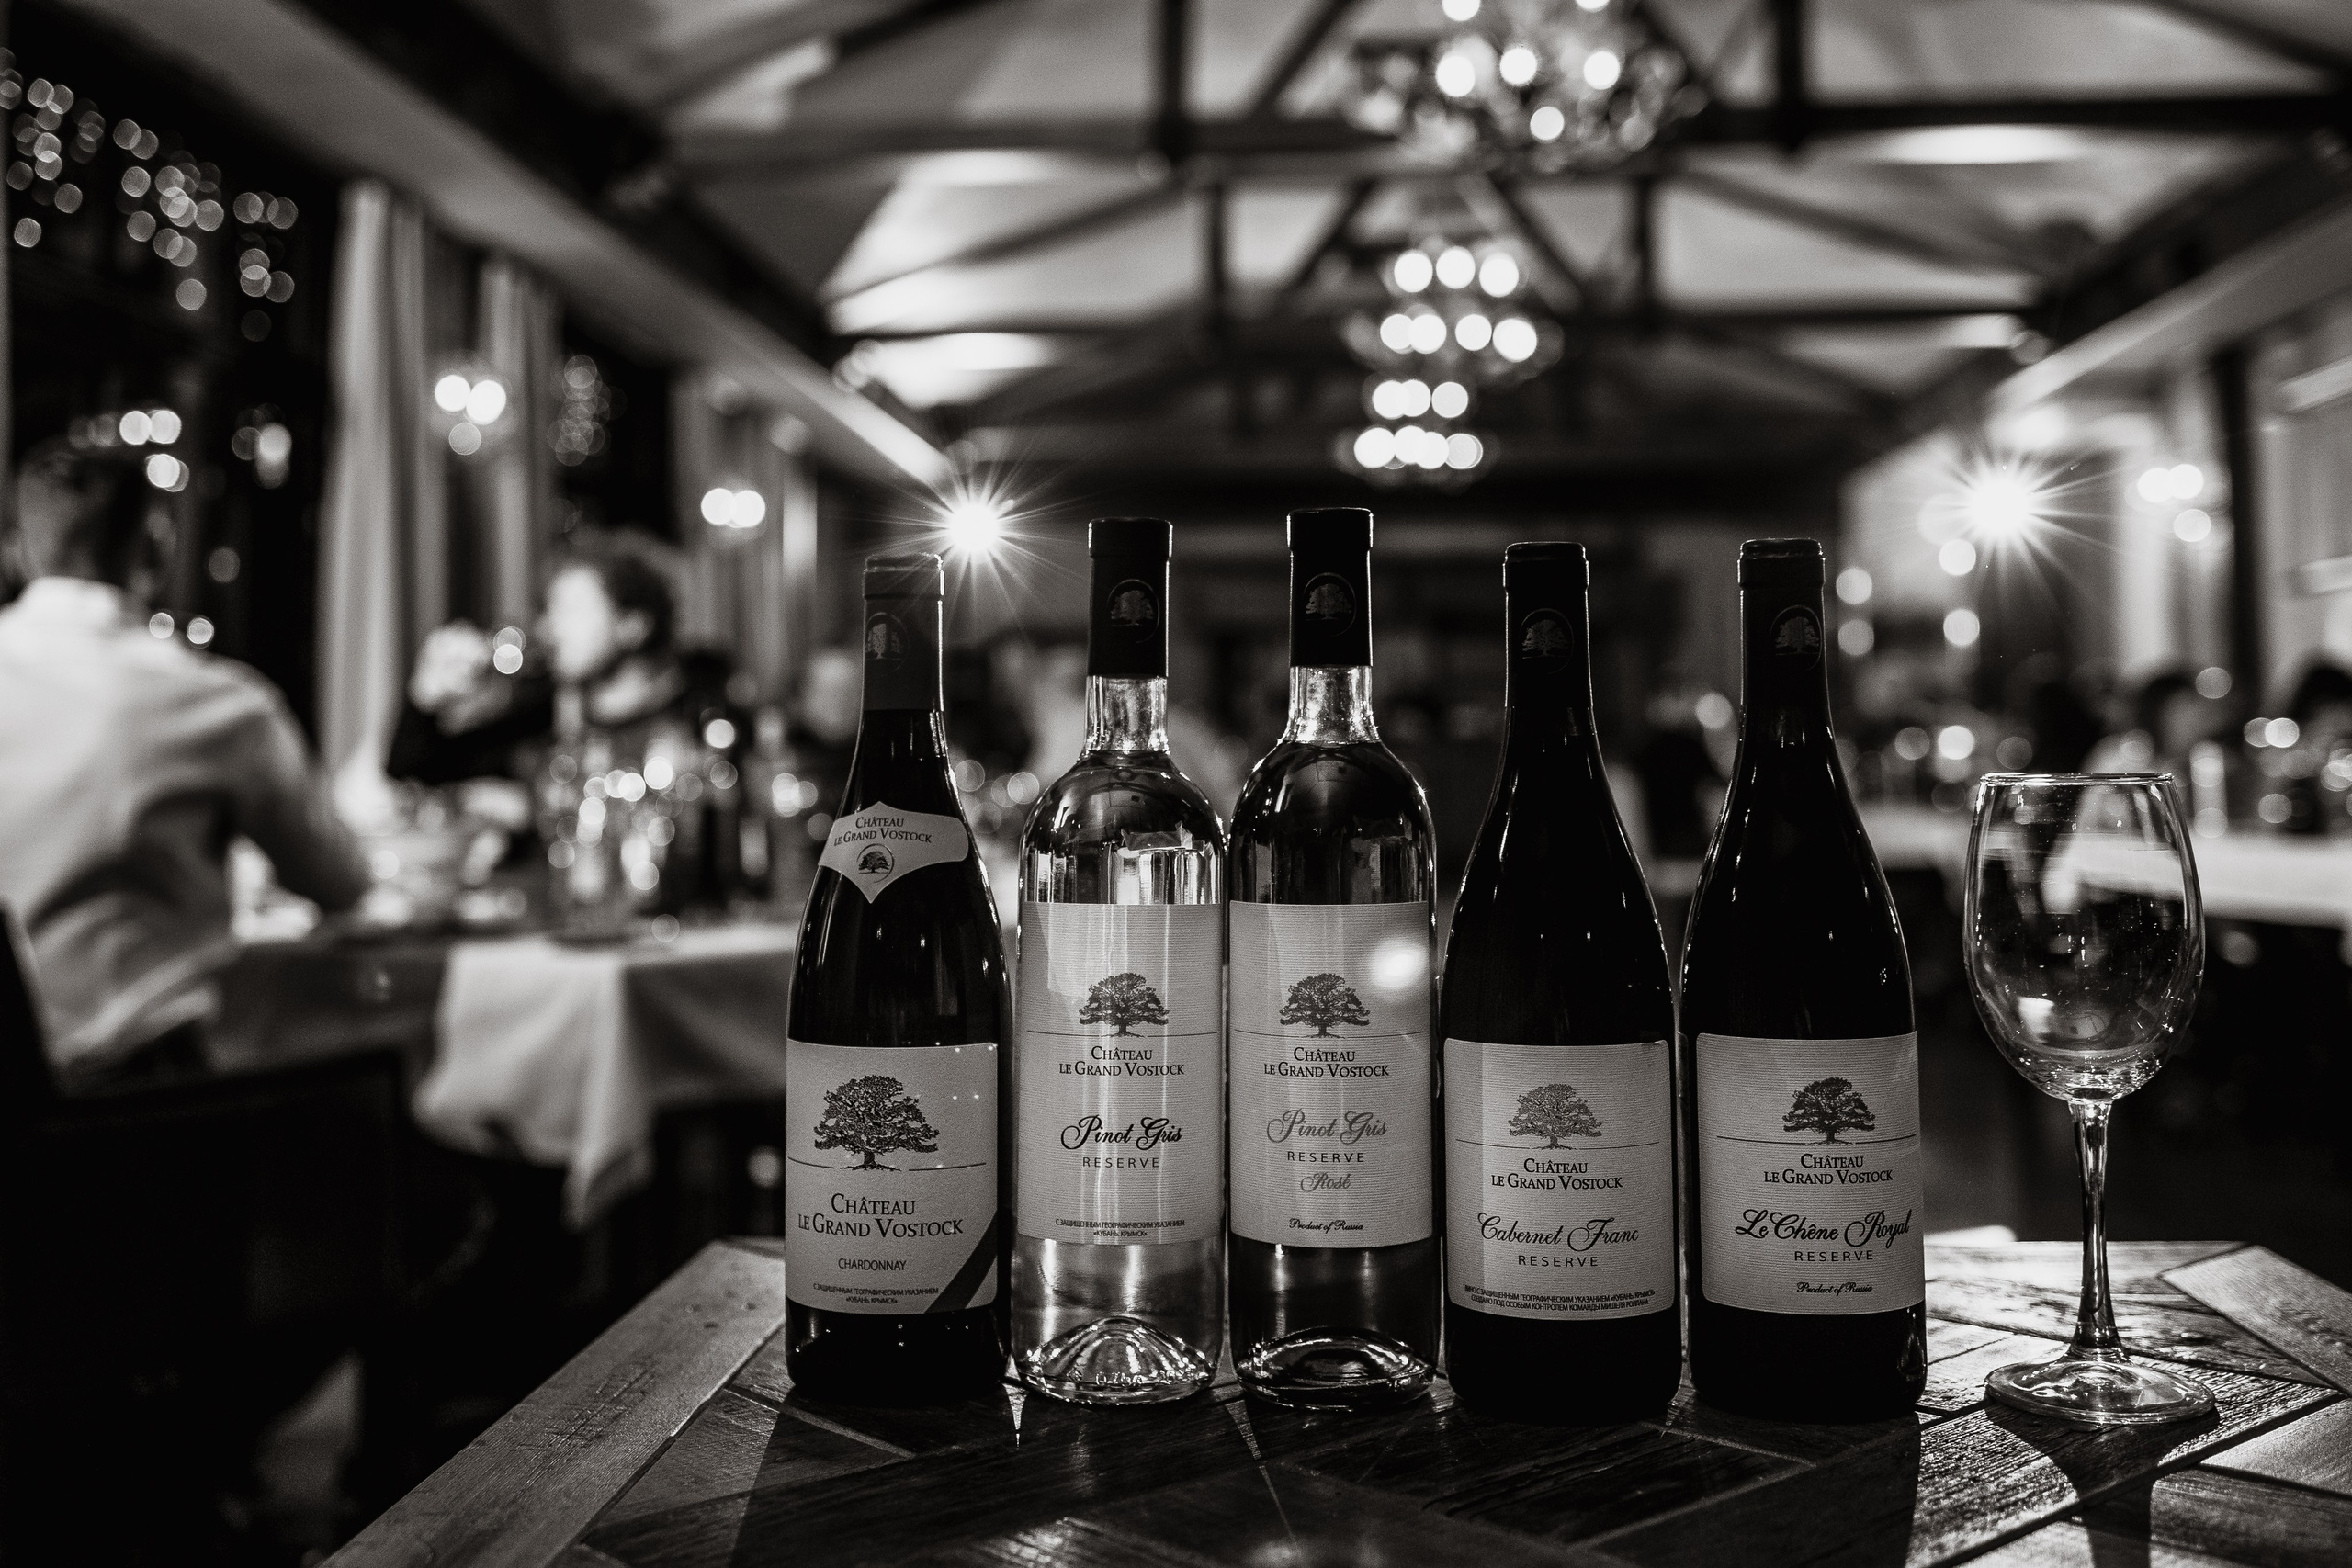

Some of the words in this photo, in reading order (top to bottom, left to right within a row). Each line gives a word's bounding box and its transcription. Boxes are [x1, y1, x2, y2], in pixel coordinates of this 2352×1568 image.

[855, 817, 904, 829] CHÂTEAU
[843, 830, 876, 843] GRAND
[879, 828, 933, 844] VOSTOCK
[1091, 1046, 1153, 1061] CHÂTEAU
[1293, 1047, 1356, 1062] CHÂTEAU
[1059, 1063, 1071, 1074] LE
[1074, 1061, 1121, 1076] GRAND
[1125, 1063, 1184, 1077] VOSTOCK
[1264, 1064, 1275, 1075] LE
[1278, 1062, 1324, 1077] GRAND
[1327, 1064, 1389, 1077] VOSTOCK
[1060, 1114, 1135, 1150] Pinot
[1136, 1117, 1182, 1151] Gris
[1267, 1108, 1337, 1144] Pinot
[1340, 1111, 1387, 1145] Gris
[1082, 1156, 1159, 1168] RESERVE
[1287, 1151, 1364, 1163] RESERVE
[1800, 1153, 1864, 1168] CHÂTEAU
[1523, 1158, 1588, 1174] CHÂTEAU
[1301, 1171, 1351, 1192] Rosé
[1491, 1175, 1504, 1186] LE
[1507, 1173, 1555, 1190] GRAND
[1558, 1175, 1623, 1190] VOSTOCK
[1764, 1171, 1780, 1183] LE
[1782, 1168, 1834, 1185] GRAND
[1836, 1169, 1894, 1185] VOSTOCK
[831, 1193, 916, 1215] CHÂTEAU
[798, 1213, 810, 1232] LE
[812, 1213, 871, 1237] GRAND
[875, 1218, 964, 1238] VOSTOCK
[1289, 1218, 1323, 1231] Product
[1323, 1221, 1335, 1234] of
[1335, 1219, 1363, 1231] Russia
[1477, 1212, 1564, 1245] Cabernet
[1567, 1217, 1639, 1252] Franc
[1735, 1209, 1770, 1239] Le
[1770, 1212, 1838, 1240] Chêne
[1844, 1209, 1913, 1249] Royal
[1518, 1256, 1599, 1268] RESERVE
[1794, 1250, 1873, 1262] RESERVE
[838, 1258, 907, 1271] CHARDONNAY
[1796, 1281, 1833, 1293] Product
[1833, 1283, 1845, 1296] of
[1845, 1281, 1872, 1293] Russia
